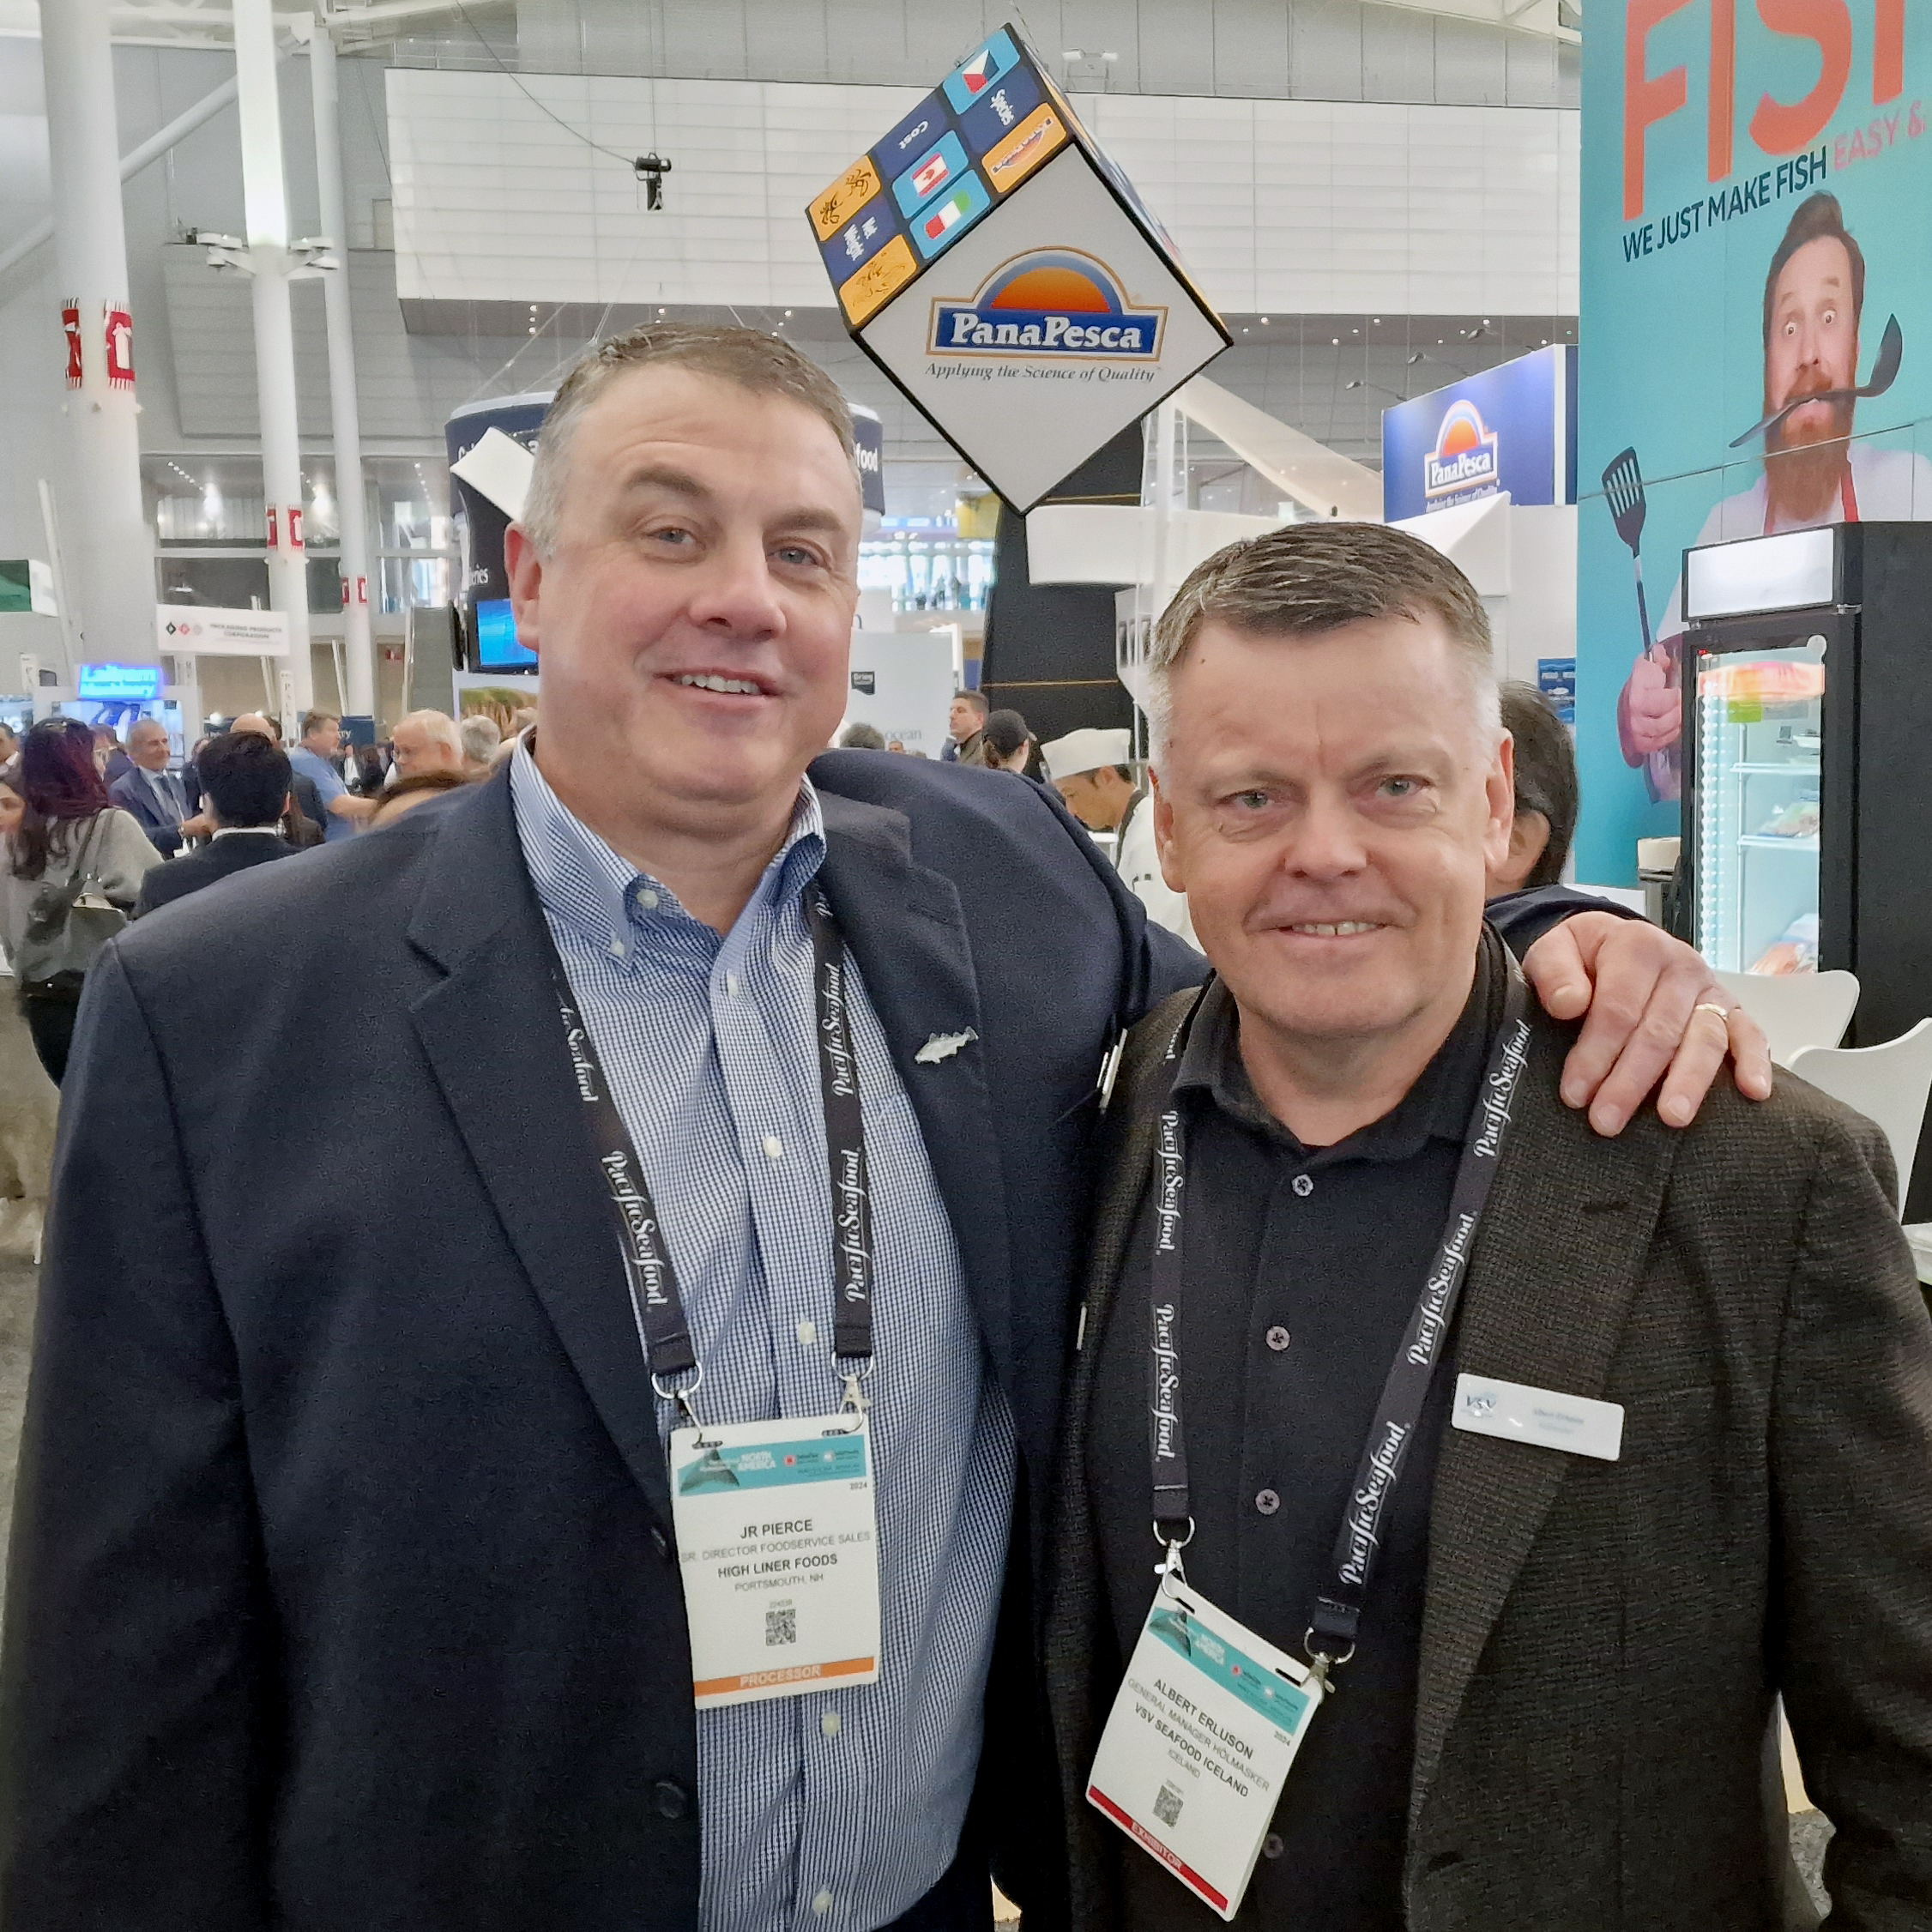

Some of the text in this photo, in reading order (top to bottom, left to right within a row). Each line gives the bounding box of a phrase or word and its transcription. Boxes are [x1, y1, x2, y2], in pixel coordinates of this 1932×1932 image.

[898, 120, 929, 150] Cost
[1622, 224, 1653, 263] WE
[1657, 200, 1704, 250] JUST
[1708, 171, 1772, 227] MAKE
[1777, 144, 1827, 200] FISH
[1834, 107, 1901, 171] EASY
[950, 312, 1142, 348] PanaPesca
[925, 362, 1156, 383] Applying the Science of Quality
[1430, 452, 1493, 487] PanaPesca
[740, 1519, 813, 1539] JR PIERCE
[702, 1544, 758, 1561] DIRECTOR
[760, 1536, 836, 1555] FOODSERVICE
[837, 1531, 871, 1543] SALES
[717, 1554, 838, 1579] HIGH LINER FOODS
[811, 1573, 824, 1584] NH
[740, 1664, 822, 1688] PROCESSOR
[1128, 1678, 1166, 1713] GENERAL
[1168, 1710, 1212, 1748] MANAGER
[1154, 1679, 1198, 1716] ALBERT
[1198, 1712, 1253, 1760] ERLUSON
[1135, 1702, 1248, 1797] VSV SEAFOOD ICELAND
[1168, 1748, 1201, 1778] ICELAND
[1131, 1820, 1182, 1871] EXHIBITOR
